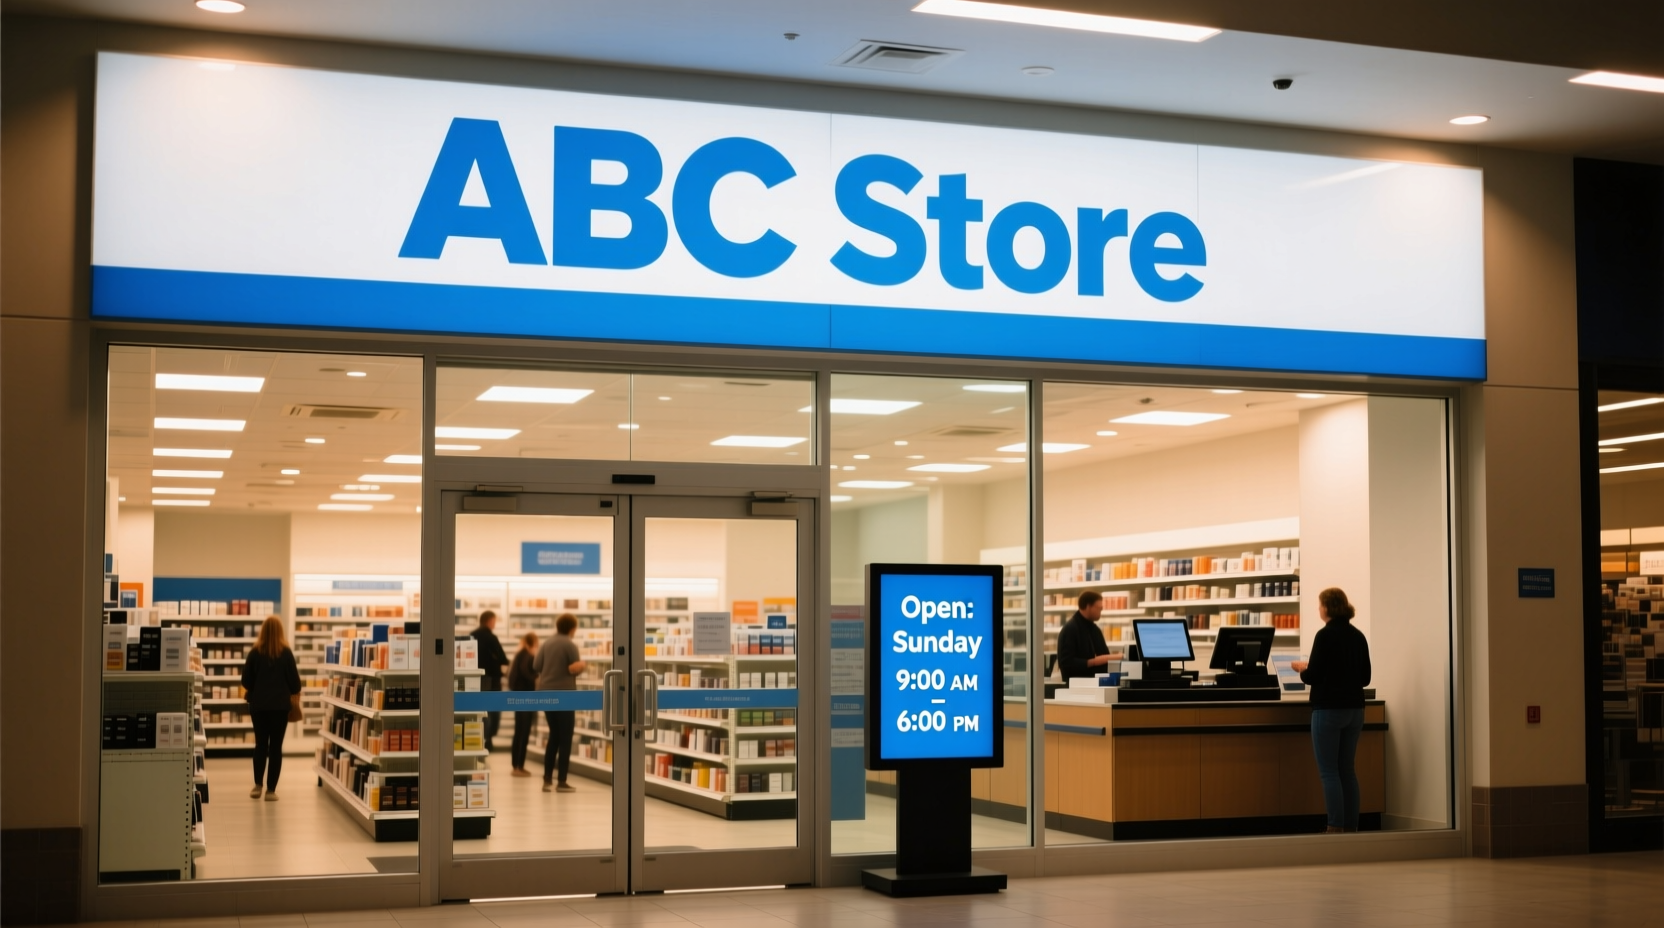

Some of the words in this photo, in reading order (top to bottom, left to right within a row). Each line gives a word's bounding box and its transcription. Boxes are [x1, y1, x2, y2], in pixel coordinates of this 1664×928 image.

[398, 116, 798, 279] ABC
[829, 153, 1208, 303] Store
[900, 595, 974, 625] Open:
[892, 630, 983, 660] Sunday
[895, 668, 946, 691] 9:00
[950, 675, 979, 691] AM
[896, 709, 947, 733] 6:00
[953, 714, 979, 732] PM
